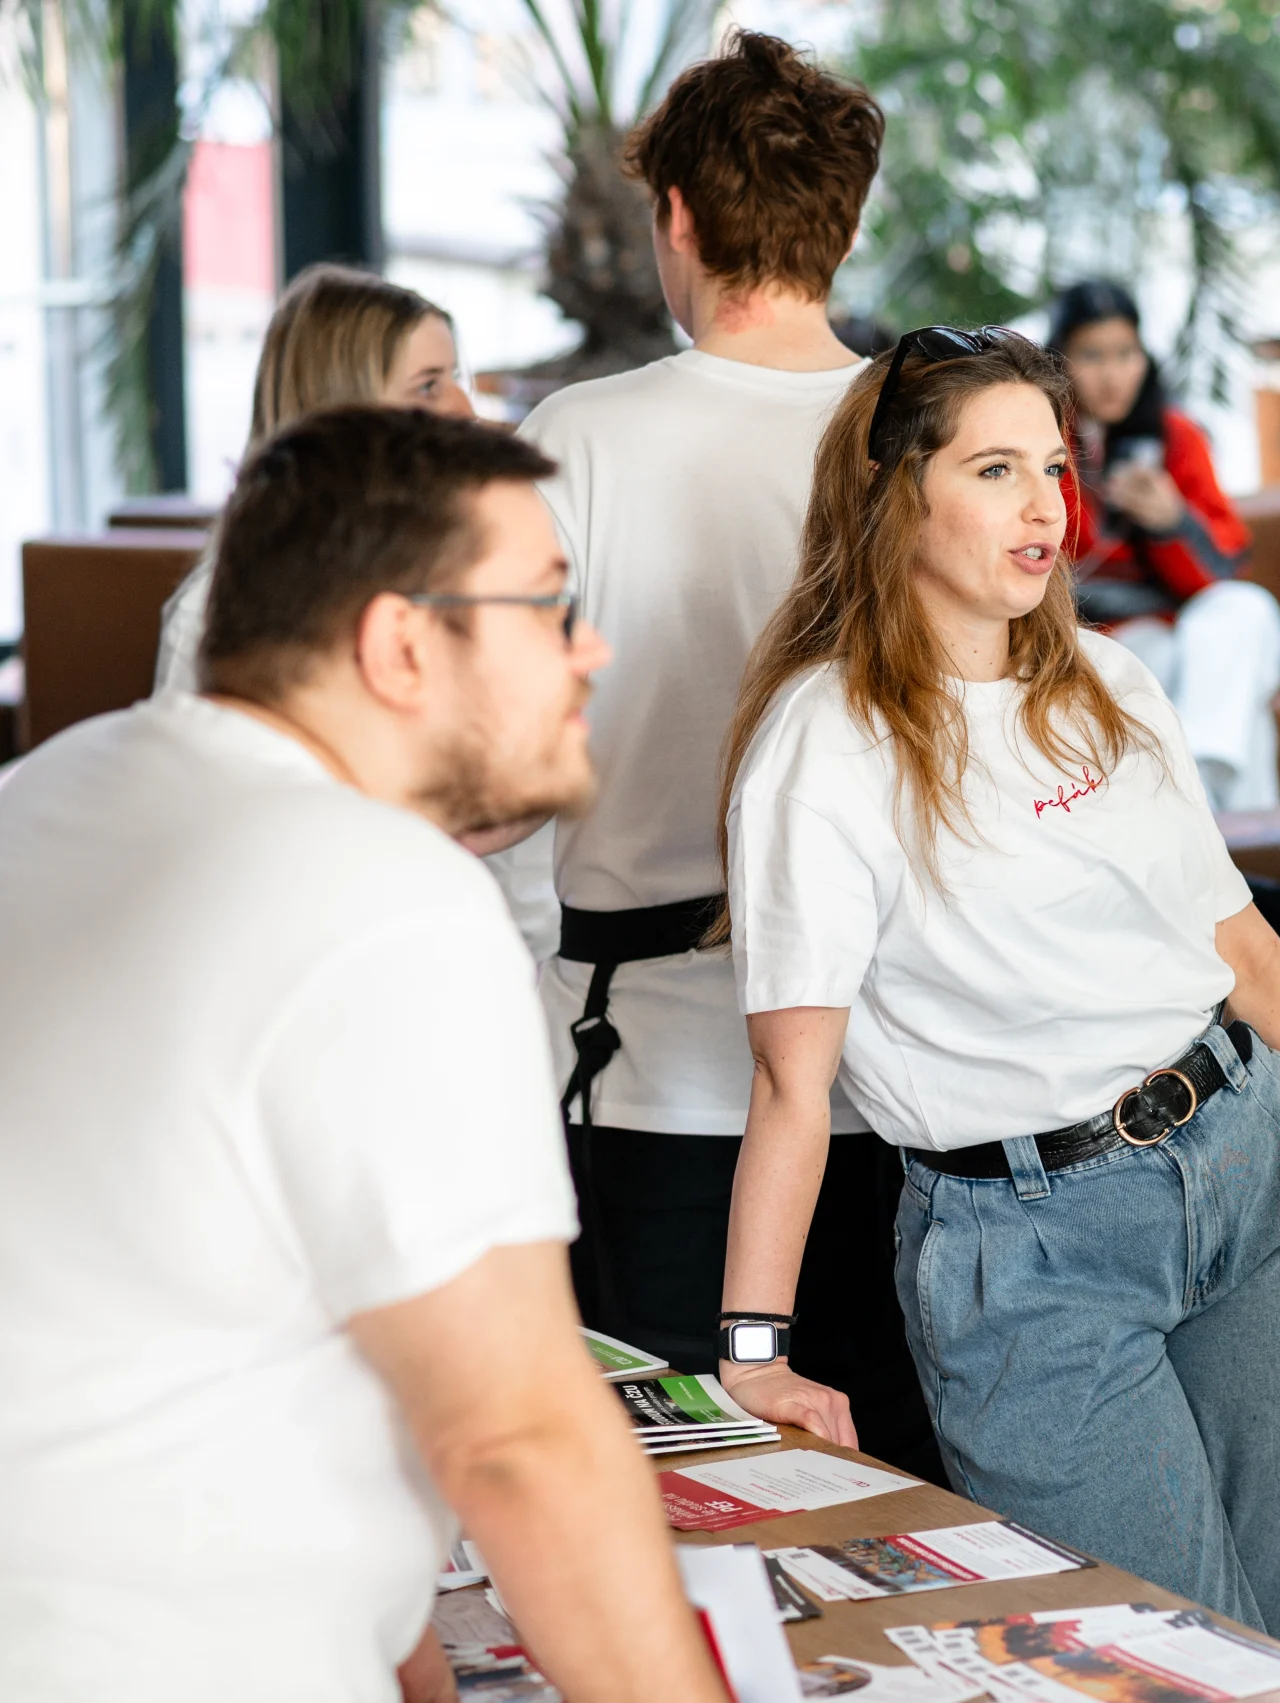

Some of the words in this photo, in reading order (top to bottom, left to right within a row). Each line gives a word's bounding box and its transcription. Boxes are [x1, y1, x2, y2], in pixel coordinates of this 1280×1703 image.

[623, 1385, 643, 1398] ČZU
[634, 1398, 652, 1408] NA
[704, 1500, 743, 1513] PEF
